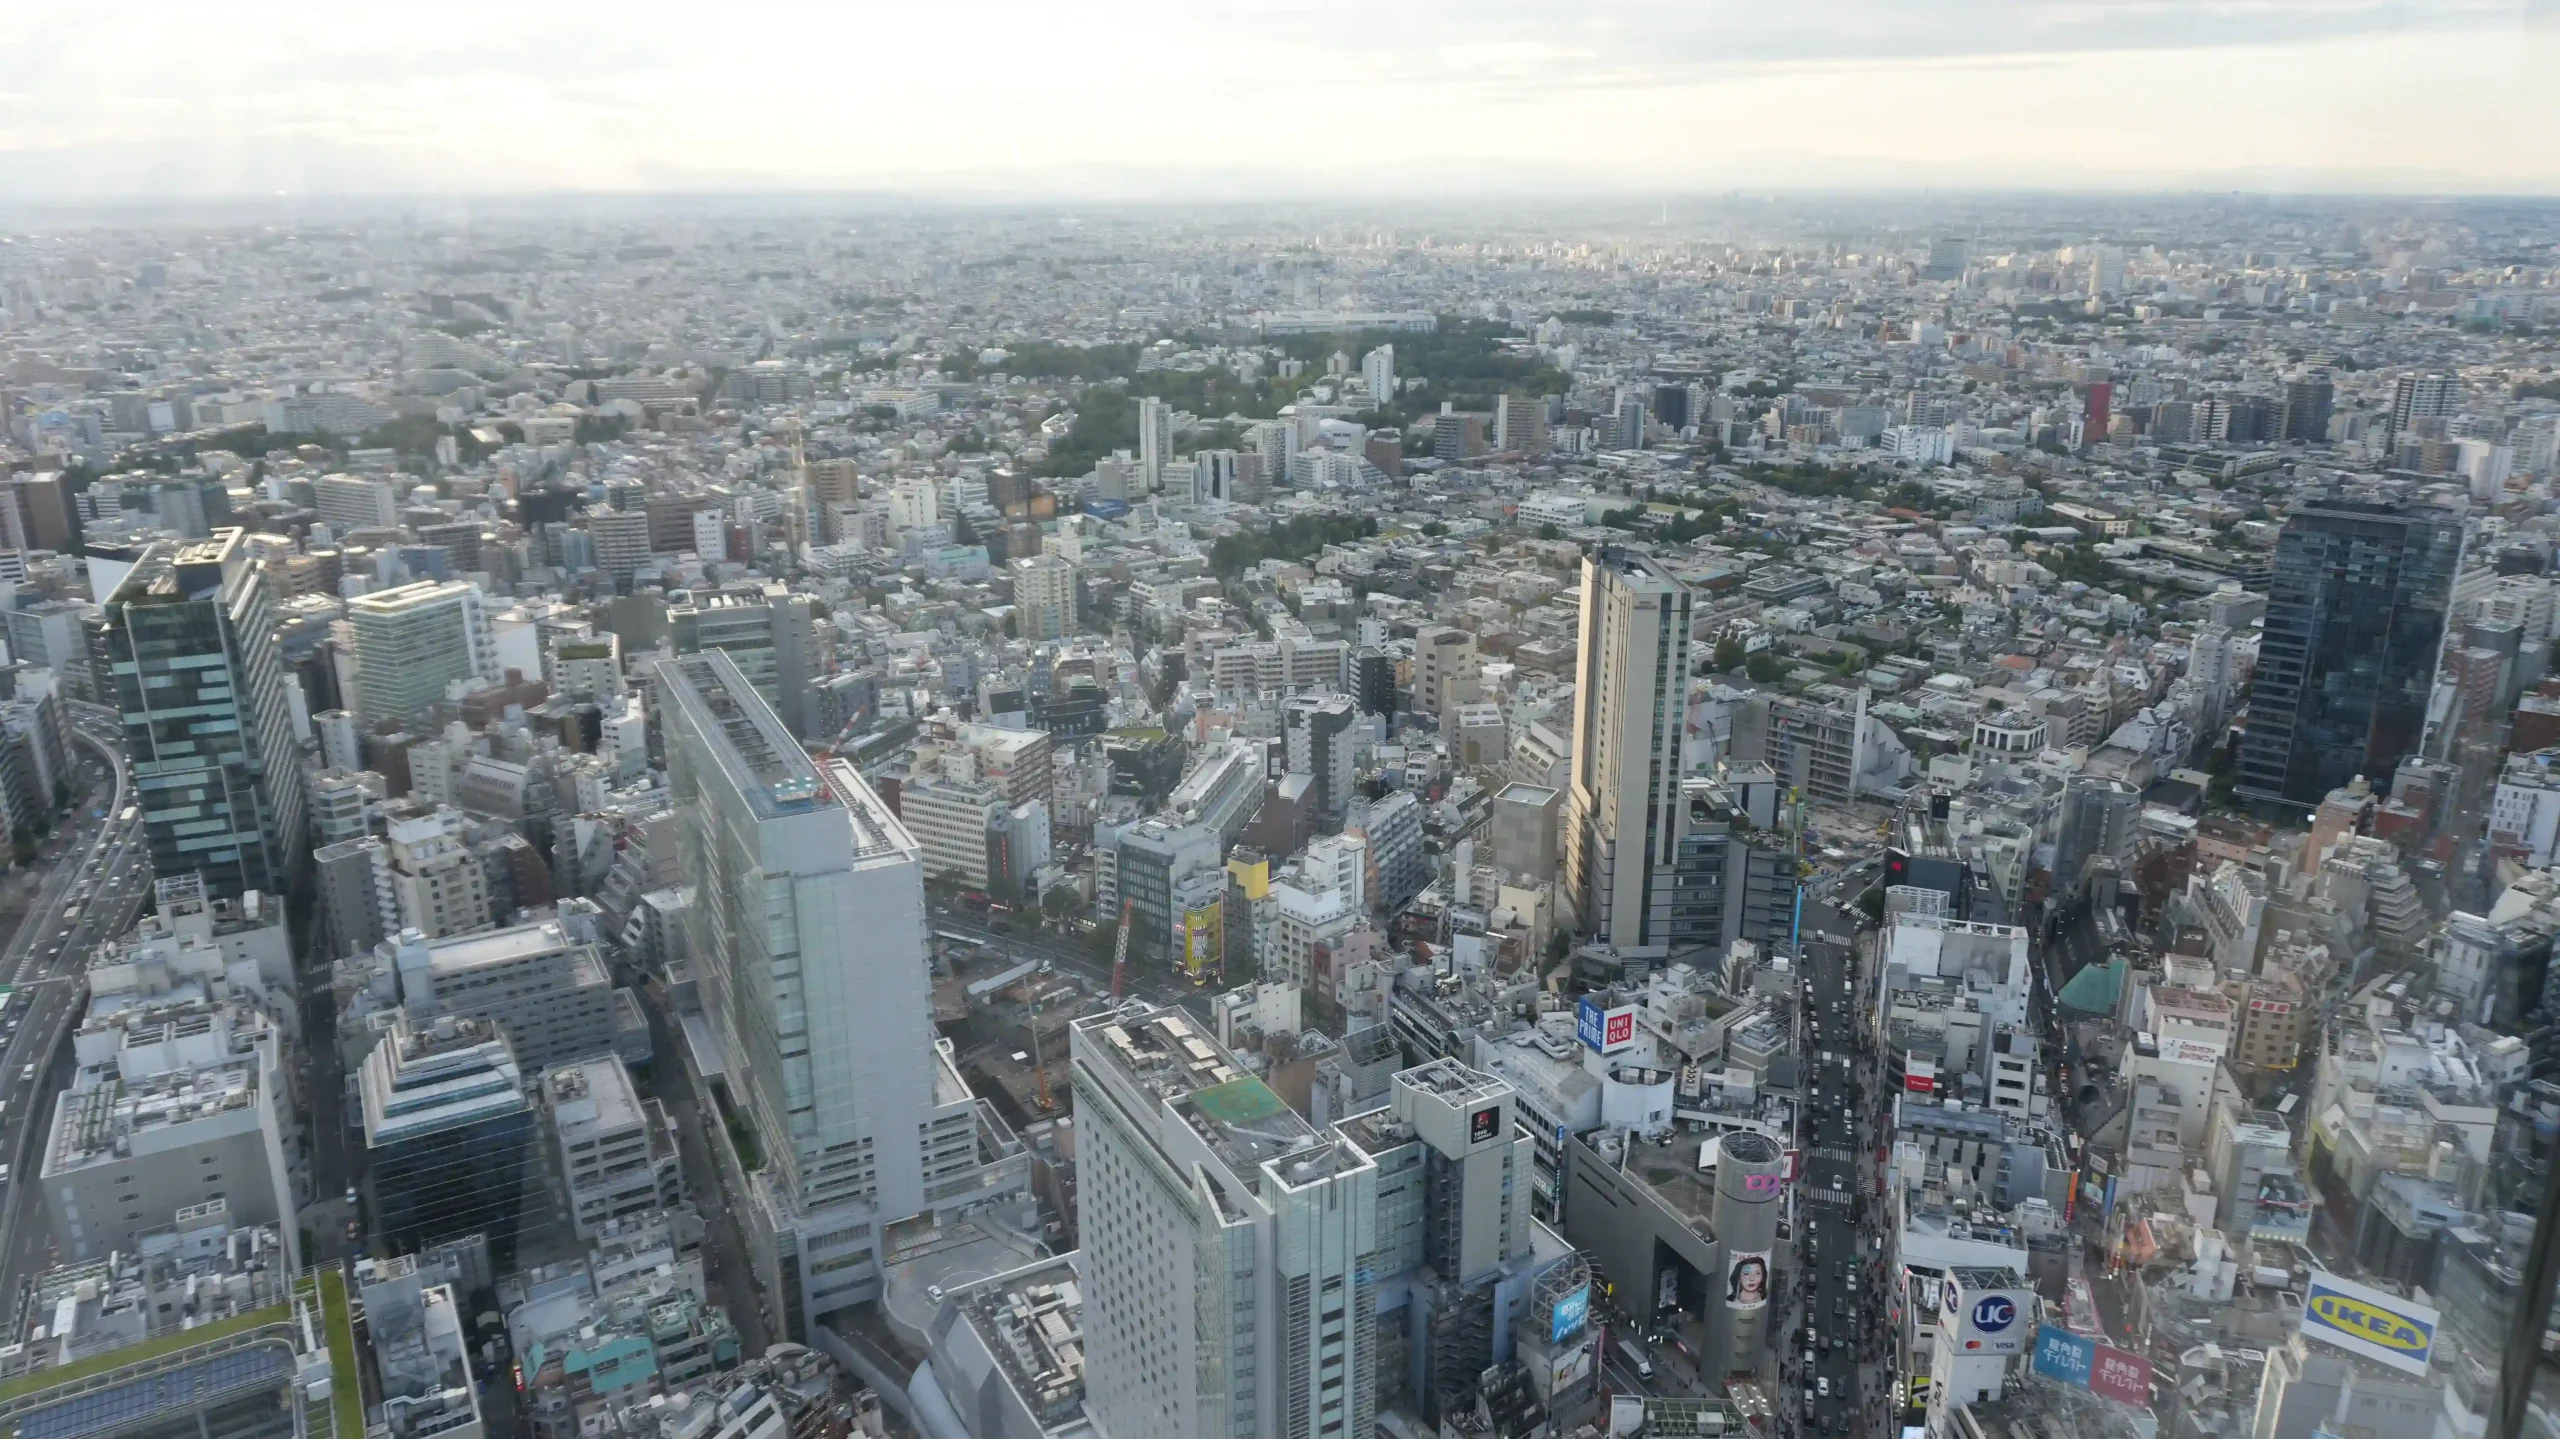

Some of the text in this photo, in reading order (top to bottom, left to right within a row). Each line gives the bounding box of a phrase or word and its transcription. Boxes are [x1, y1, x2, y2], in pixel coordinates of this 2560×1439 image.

[1585, 1006, 1599, 1028] THE
[1609, 1016, 1628, 1030] UNI
[1579, 1019, 1602, 1047] PRIME
[1609, 1027, 1629, 1042] QLO
[1975, 1305, 2013, 1324] UC
[2321, 1299, 2418, 1347] IKEA
